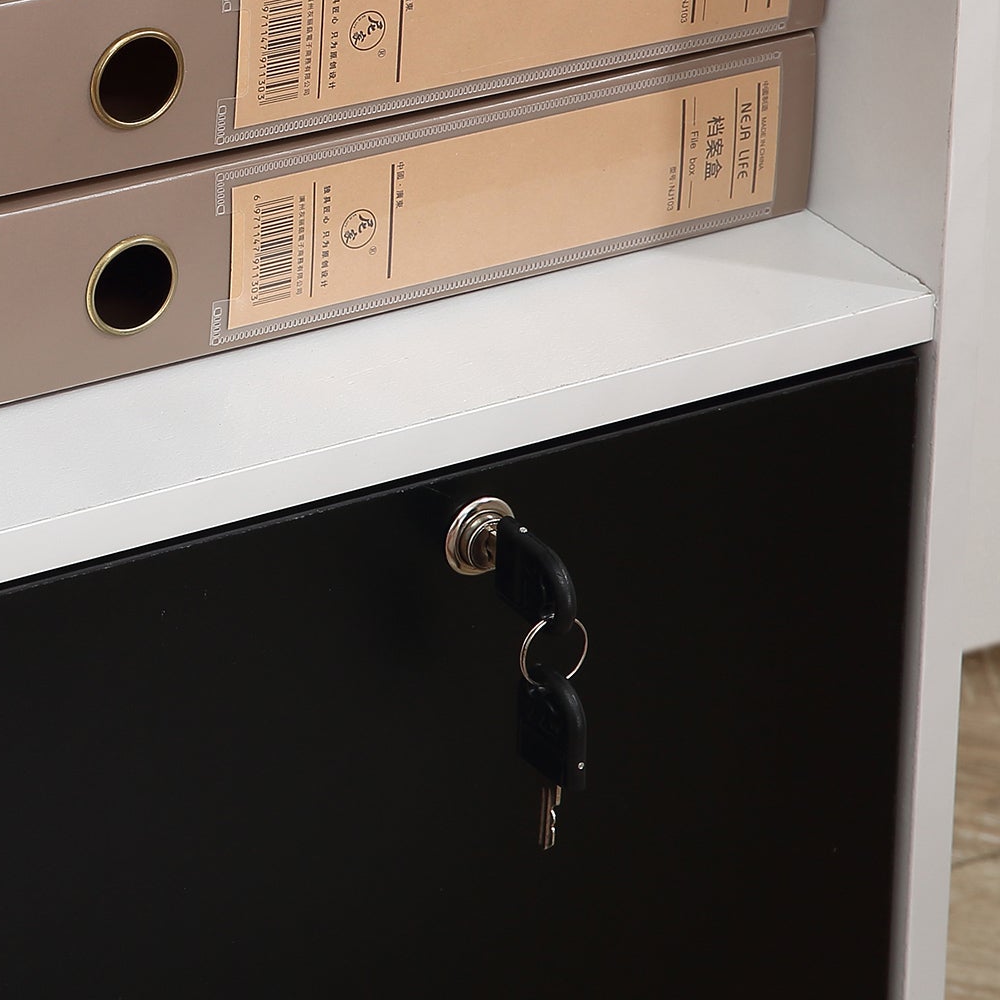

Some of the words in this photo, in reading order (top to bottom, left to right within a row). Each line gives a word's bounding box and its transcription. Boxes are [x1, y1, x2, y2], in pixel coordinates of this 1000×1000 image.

[260, 6, 270, 51] 971147
[256, 57, 267, 101] 911303
[689, 130, 699, 150] File
[739, 102, 753, 141] NEJA
[760, 116, 768, 138] MADE
[688, 157, 698, 176] box
[703, 115, 726, 181] 档案盒
[736, 149, 751, 180] LIFE
[758, 148, 766, 170] CHINA
[252, 208, 262, 252] 971147
[250, 257, 260, 301] 911303
